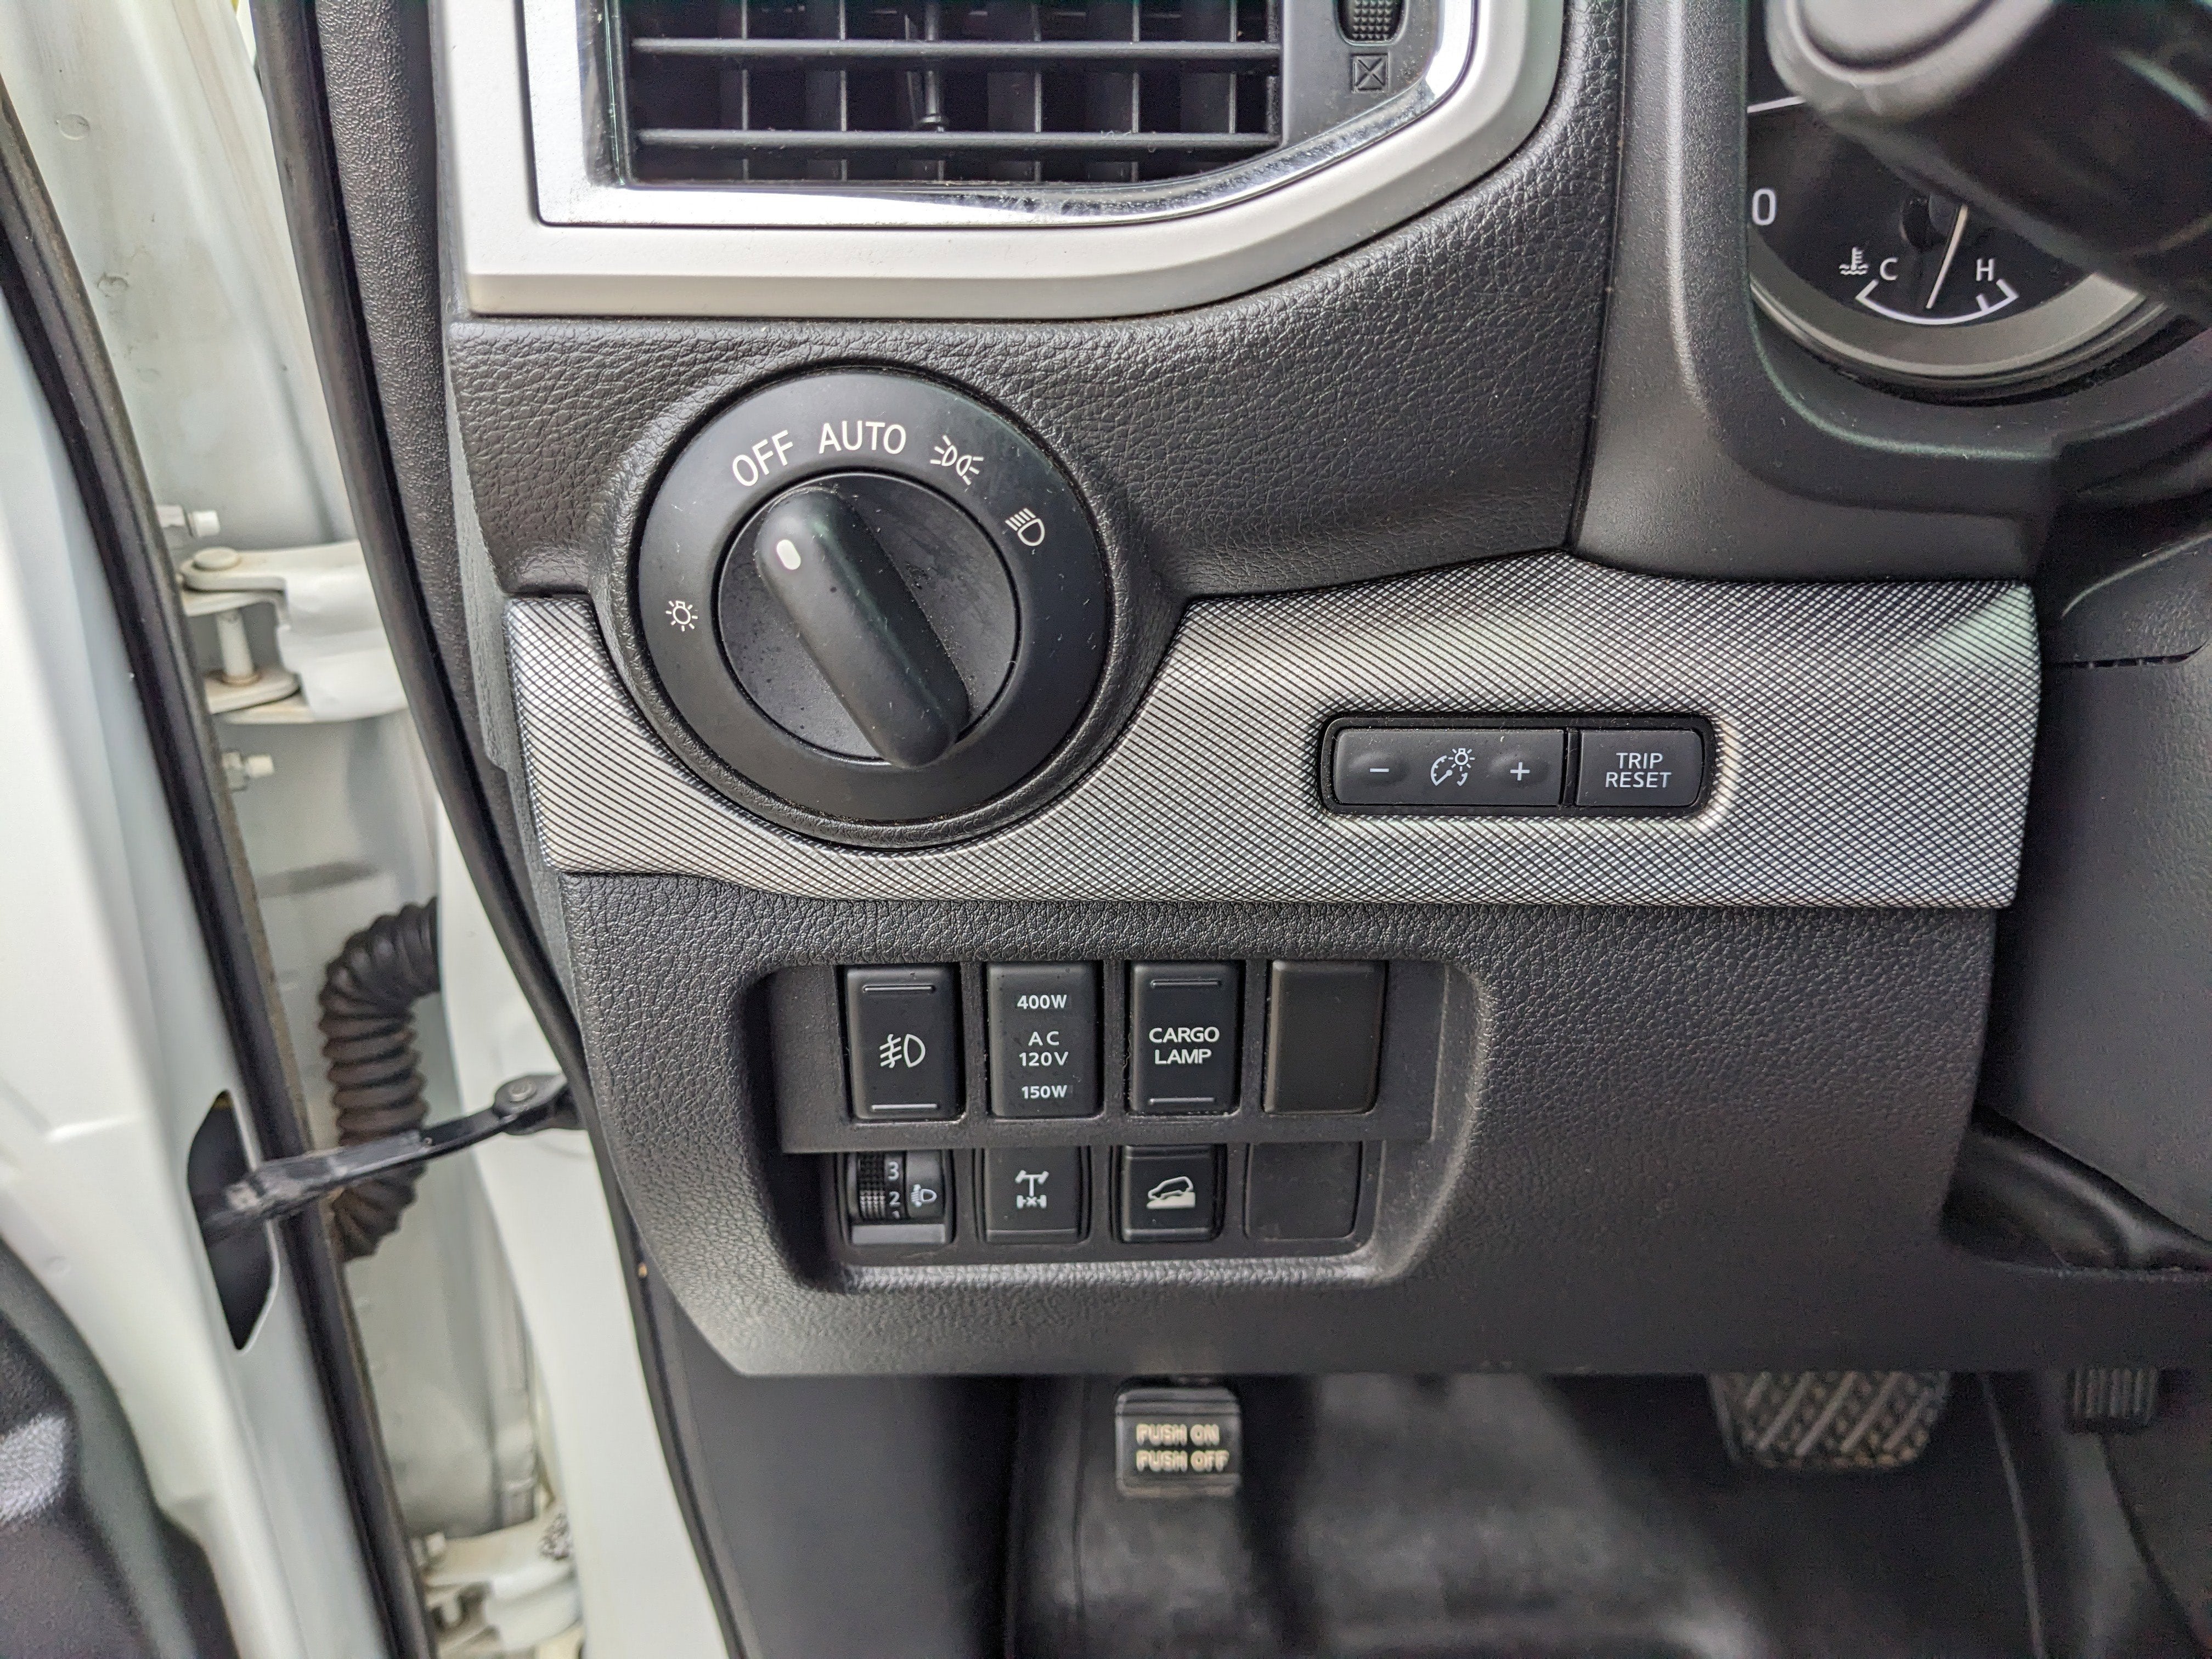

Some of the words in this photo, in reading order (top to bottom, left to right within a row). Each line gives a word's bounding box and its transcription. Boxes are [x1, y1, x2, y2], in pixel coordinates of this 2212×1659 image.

[1752, 188, 1776, 225] 0
[1879, 257, 1898, 281] C
[1976, 258, 1994, 282] H
[818, 420, 907, 455] AUTO
[731, 429, 794, 487] OFF
[1615, 752, 1663, 770] TRIP
[1605, 771, 1672, 788] RESET
[1017, 994, 1068, 1010] 400W
[1148, 1026, 1220, 1044] CARGO
[1018, 1051, 1069, 1067] 120V
[1154, 1048, 1212, 1065] LAMP
[1021, 1084, 1068, 1099] 150W
[887, 1160, 900, 1181] 3
[889, 1190, 901, 1206] 2
[1136, 1423, 1188, 1446] PUSH
[1189, 1424, 1221, 1447] ON
[1136, 1449, 1188, 1472] PUSH
[1190, 1449, 1230, 1472] OFF
